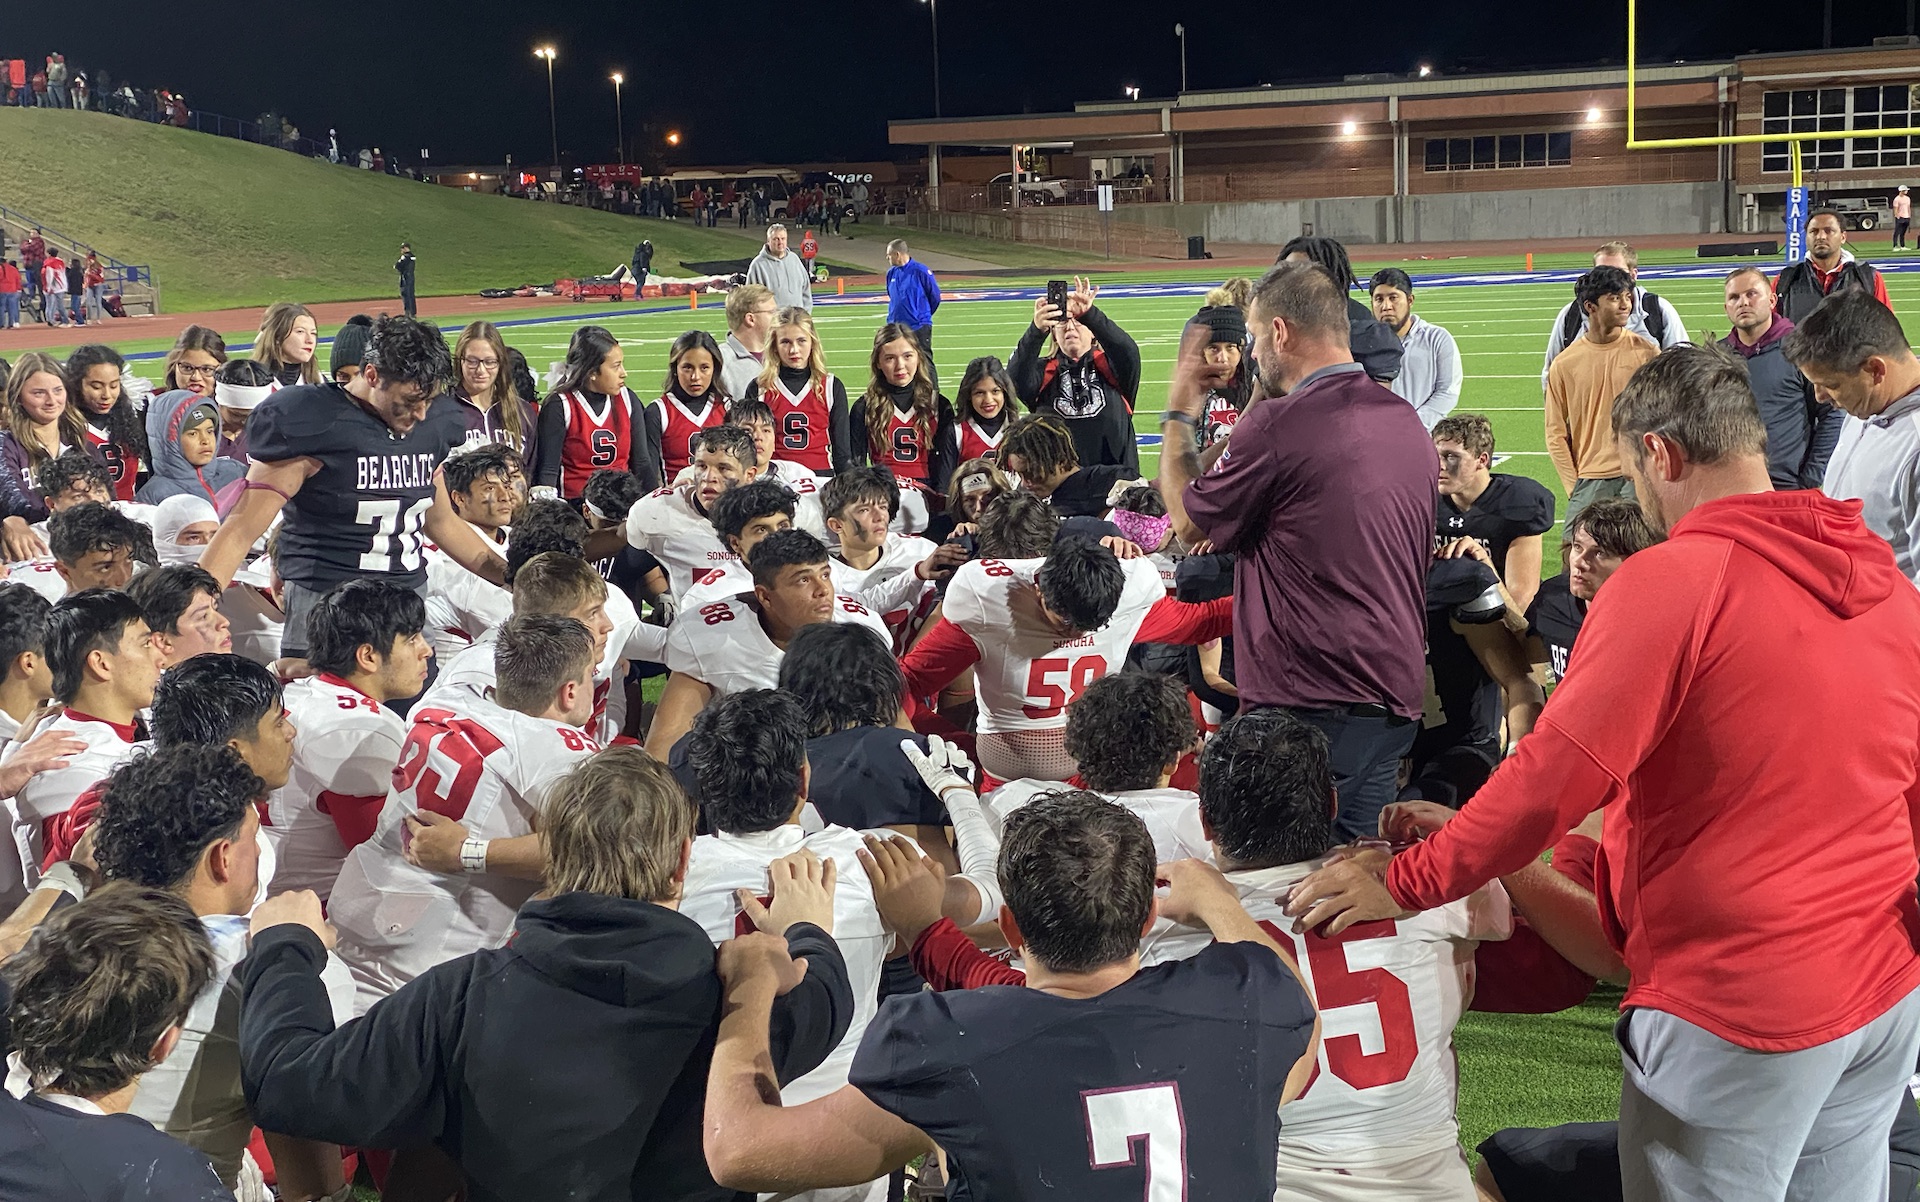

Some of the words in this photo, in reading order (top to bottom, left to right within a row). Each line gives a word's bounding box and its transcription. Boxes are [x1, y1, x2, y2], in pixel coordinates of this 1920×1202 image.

[1789, 188, 1802, 262] SAISD
[591, 429, 617, 467] S
[783, 412, 809, 450] S
[893, 427, 918, 462] S
[356, 454, 434, 489] BEARCATS
[355, 497, 434, 571] 70
[699, 602, 735, 626] 88
[336, 694, 380, 714] 54
[1258, 917, 1419, 1100] 5
[1079, 1081, 1188, 1202] 7
